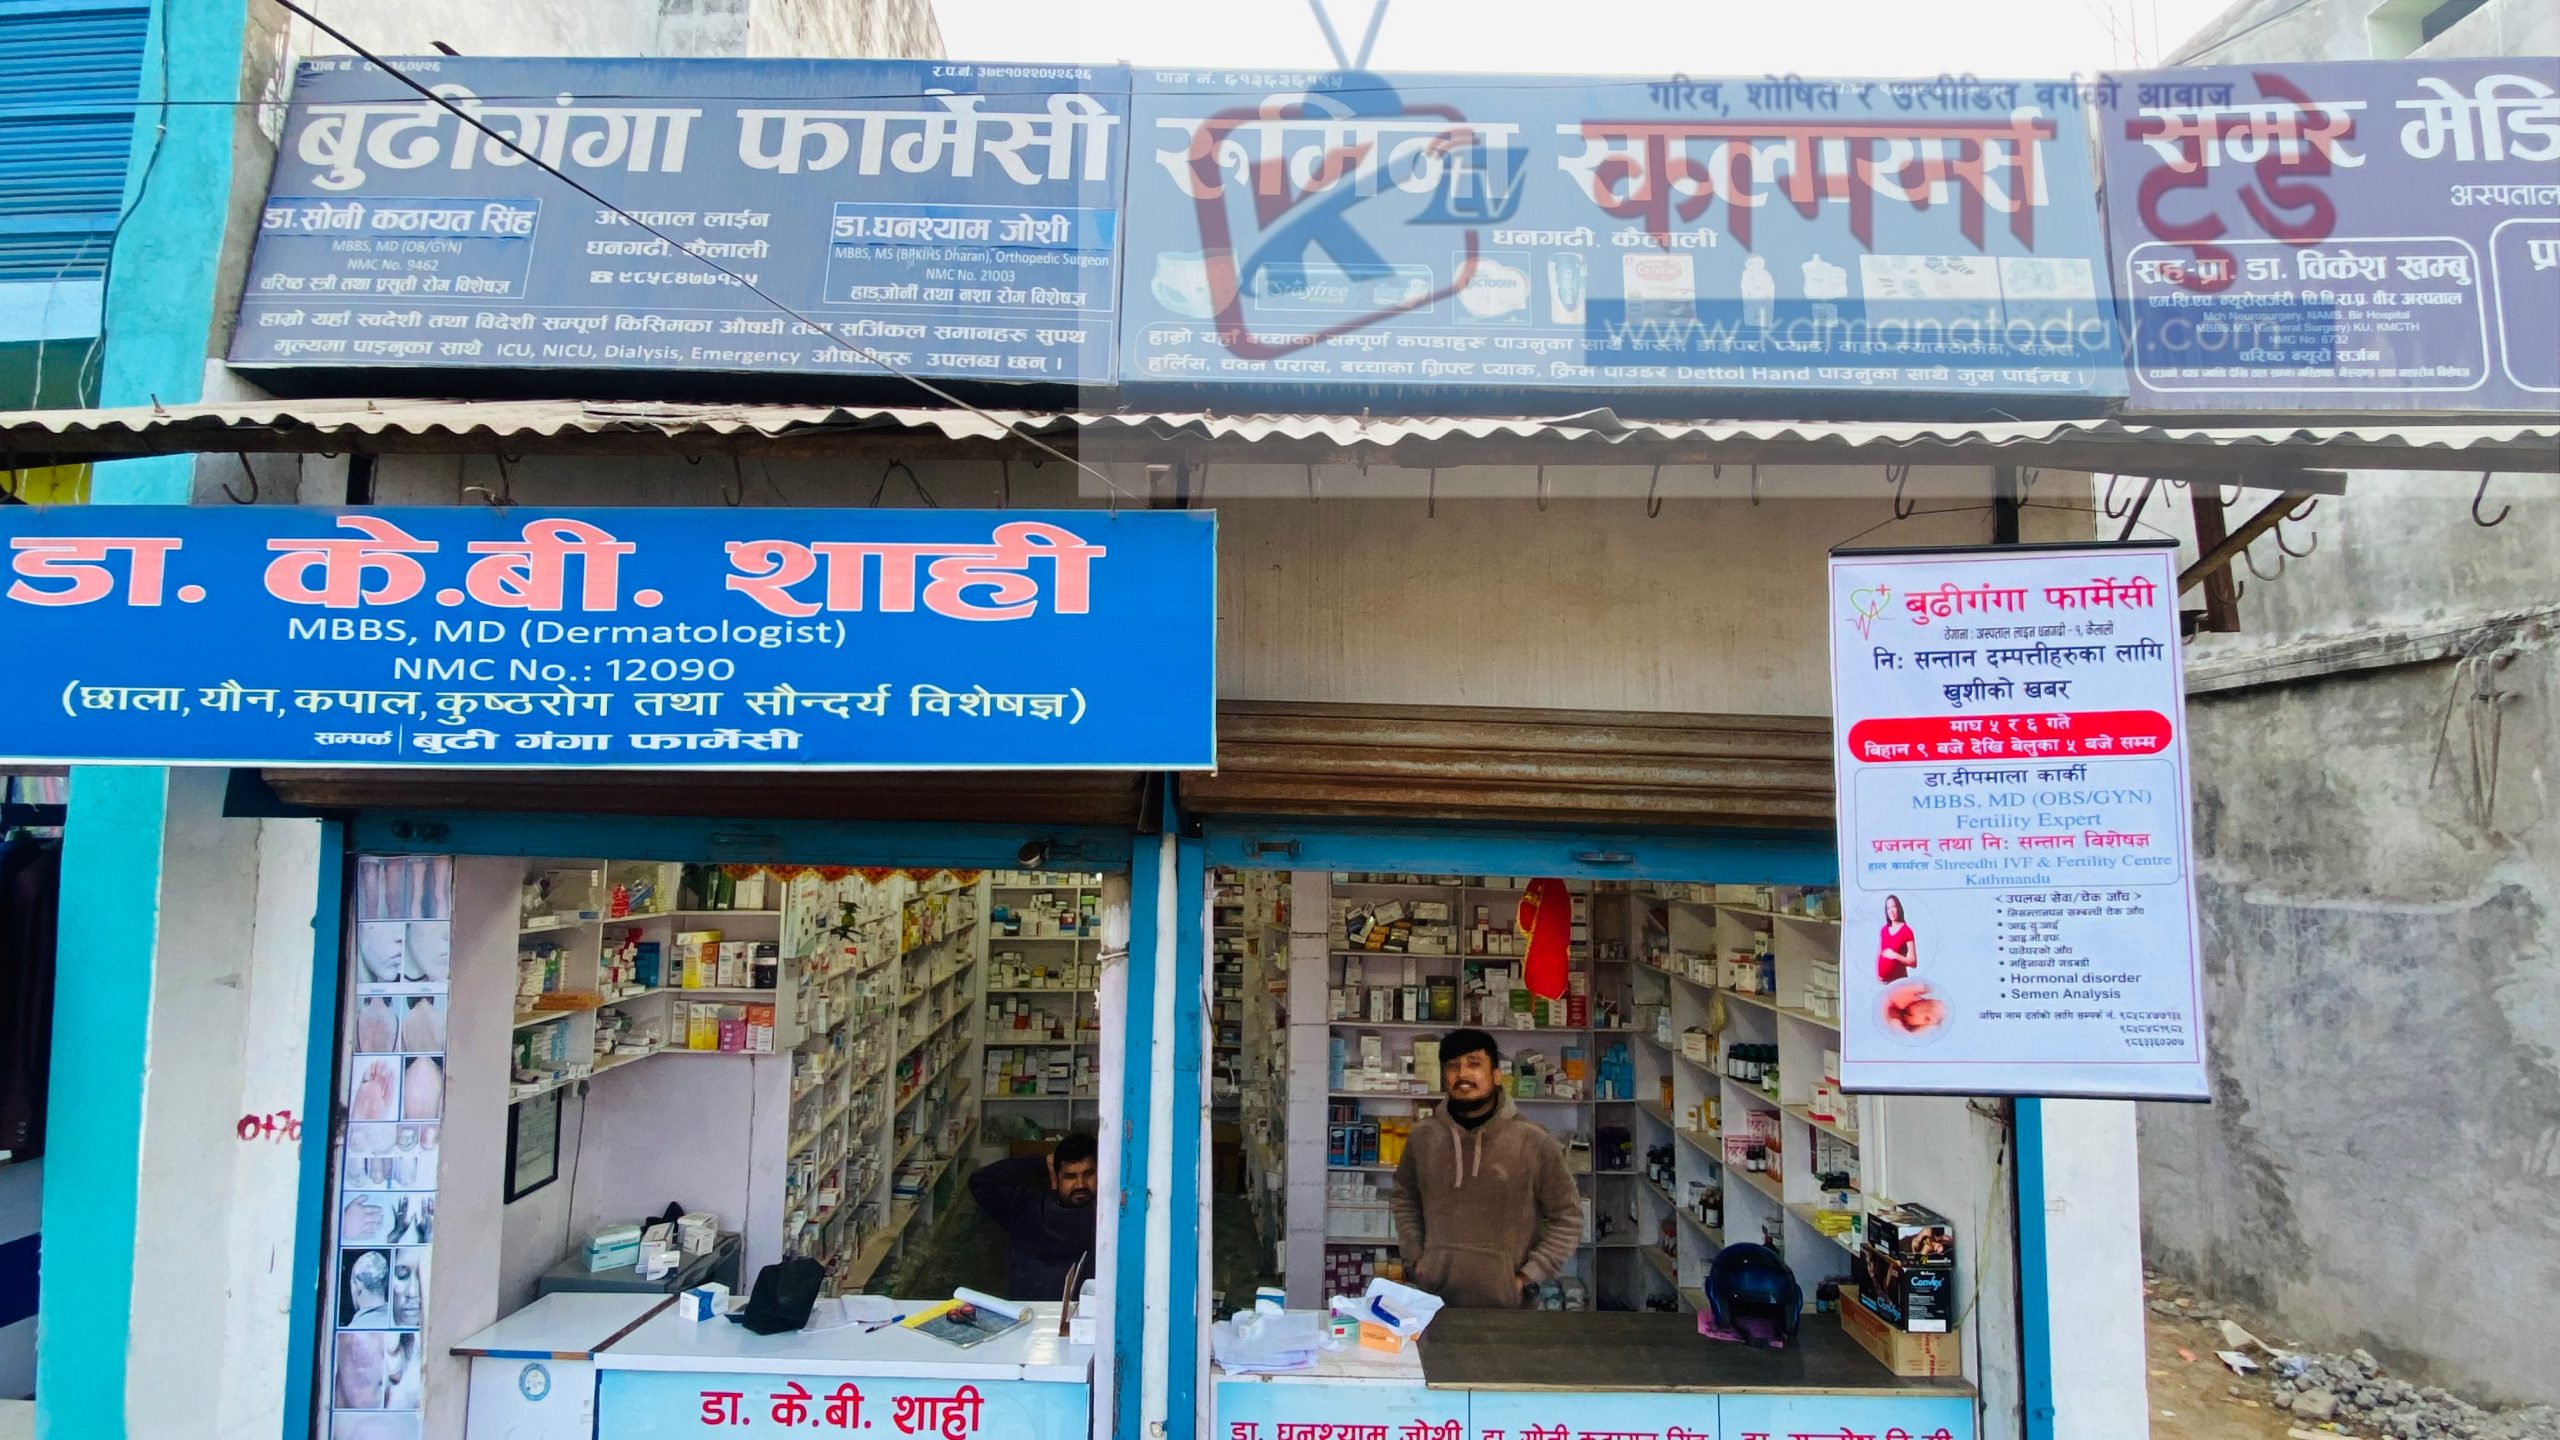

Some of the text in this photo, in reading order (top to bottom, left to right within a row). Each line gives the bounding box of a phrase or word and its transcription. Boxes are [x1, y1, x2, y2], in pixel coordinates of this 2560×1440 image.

[736, 88, 1120, 186] फार्मेसी
[2139, 100, 2367, 174] समर
[371, 207, 472, 233] कठायत
[480, 204, 536, 236] सिंह
[703, 208, 771, 229] लाईन
[1000, 212, 1071, 244] जोशी
[332, 240, 463, 255] MBBS, MD (OB/GYN)
[682, 237, 770, 259] कैलाली
[1611, 226, 1719, 249] कैलाली
[347, 259, 377, 271] NMC
[407, 260, 440, 273] 9462
[834, 248, 872, 262] MBBS,
[875, 249, 894, 261] MS
[996, 251, 1060, 268] Orthopedic
[1062, 254, 1110, 270] Surgeon
[2245, 256, 2288, 282] डा.
[340, 277, 370, 291] तथा
[926, 268, 1016, 282] NMC No. 21003
[428, 314, 468, 331] तथा
[2366, 311, 2411, 323] Hospital
[2269, 335, 2350, 346] NMC 6732
[497, 343, 536, 360] ICU,
[543, 343, 598, 361] NICU,
[604, 345, 685, 363] Dialysis,
[691, 347, 801, 366] Emergency
[1677, 365, 1744, 380] Dettol
[1752, 366, 1810, 381] Hand
[7, 515, 1107, 622] डा. के.बी. शाही
[1904, 575, 2158, 625] बुढीगंगा फार्मेसी
[288, 617, 847, 651] MBBS, MD (Dermatologist)
[1914, 649, 1978, 671] सन्तान
[2115, 637, 2165, 663] लागि
[393, 657, 735, 683] NMC No.: 12090
[635, 690, 723, 717] तथा
[745, 682, 891, 720] सौन्दर्य
[910, 683, 1087, 725] विशेषज्ञ)
[1943, 678, 2073, 708] खुशीको खबर
[1950, 718, 1982, 734] माघ
[2008, 718, 2019, 733] र
[2027, 717, 2038, 733] ६
[2046, 715, 2071, 731] गते
[314, 726, 803, 756] सम्पर्क बुढी गंगा फार्मेसी
[1917, 744, 1929, 758] ९
[1937, 739, 1965, 755] बजे
[1971, 738, 2002, 756] देखि
[2011, 738, 2059, 758] बेलुका
[2085, 735, 2113, 751] बजे
[2120, 735, 2156, 750] सम्म
[2037, 763, 2087, 783] कार्की
[1912, 789, 2152, 810] MBBS, MD (OBS/GYN)
[1956, 812, 2102, 832] Fertility Expert
[1938, 838, 1973, 852] तथा
[2019, 834, 2076, 851] सन्तान
[2084, 831, 2151, 849] विशेषज्ञ
[1934, 858, 1998, 872] Shreedhi
[2003, 856, 2034, 870] IVF
[2057, 854, 2117, 871] Fertility
[2122, 853, 2173, 868] Centre
[1965, 872, 2051, 887] Kathmandu
[2010, 972, 2142, 984] Hormonal disorder
[2011, 988, 2121, 1002] Semen Analysis
[700, 1381, 985, 1440] डा. के.बी. शाही
